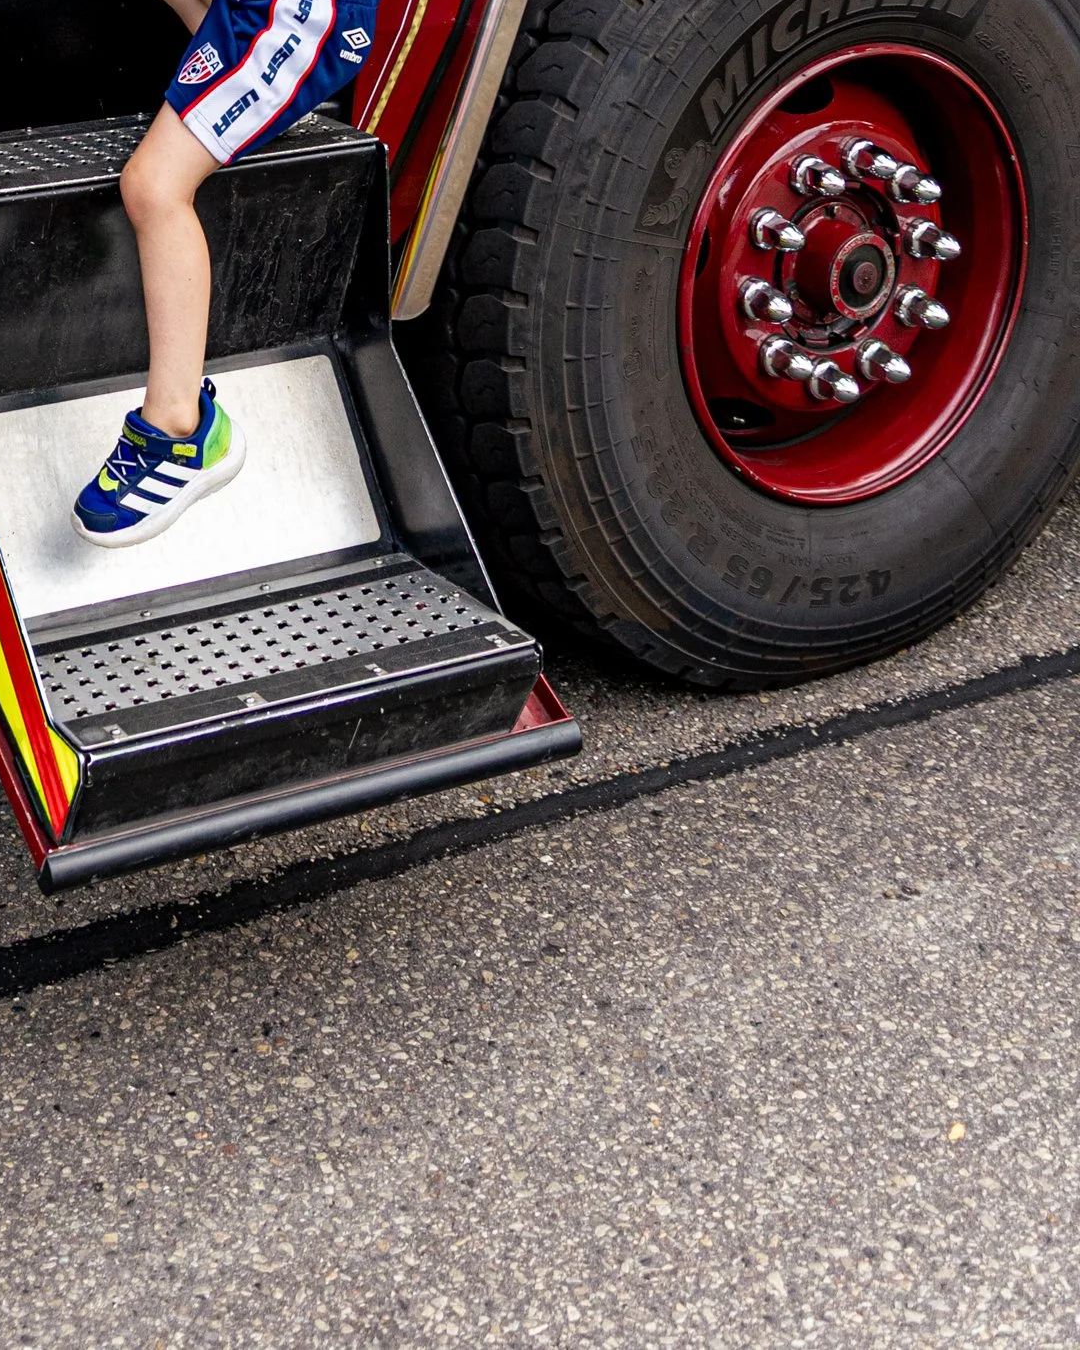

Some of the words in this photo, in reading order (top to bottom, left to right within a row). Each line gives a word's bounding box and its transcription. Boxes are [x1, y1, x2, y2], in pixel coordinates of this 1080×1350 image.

[200, 43, 222, 72] USA
[261, 33, 302, 86] USA
[339, 49, 363, 64] umbro
[212, 88, 261, 137] USA
